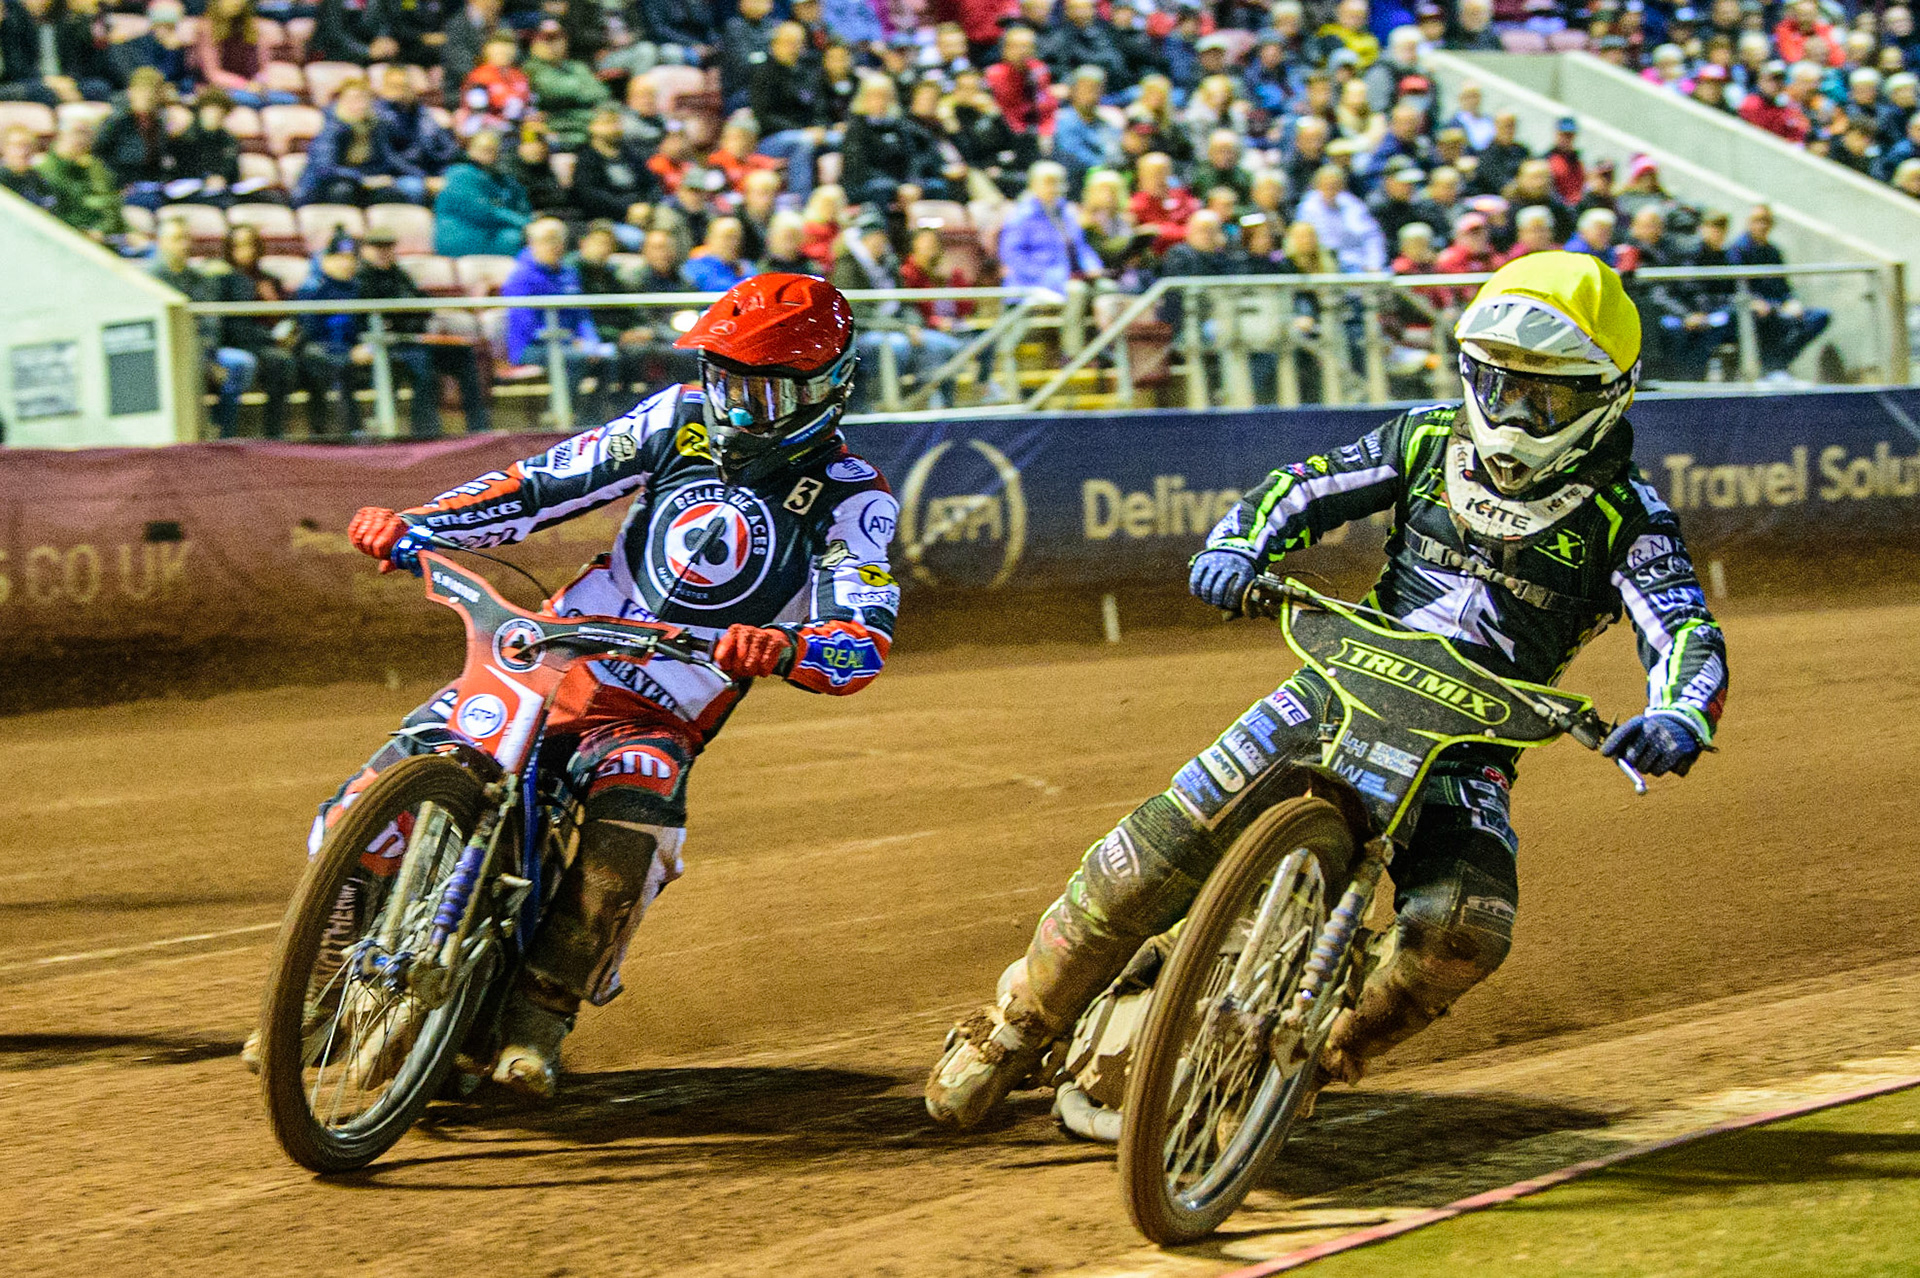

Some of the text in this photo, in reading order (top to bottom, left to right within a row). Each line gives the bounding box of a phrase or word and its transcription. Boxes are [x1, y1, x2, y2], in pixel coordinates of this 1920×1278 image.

[788, 480, 817, 511] 3
[1663, 443, 1809, 510] Travel
[673, 487, 726, 510] BELLE
[747, 514, 768, 556] ACES
[1465, 497, 1531, 531] KITE
[1348, 646, 1496, 719] TRU MIX
